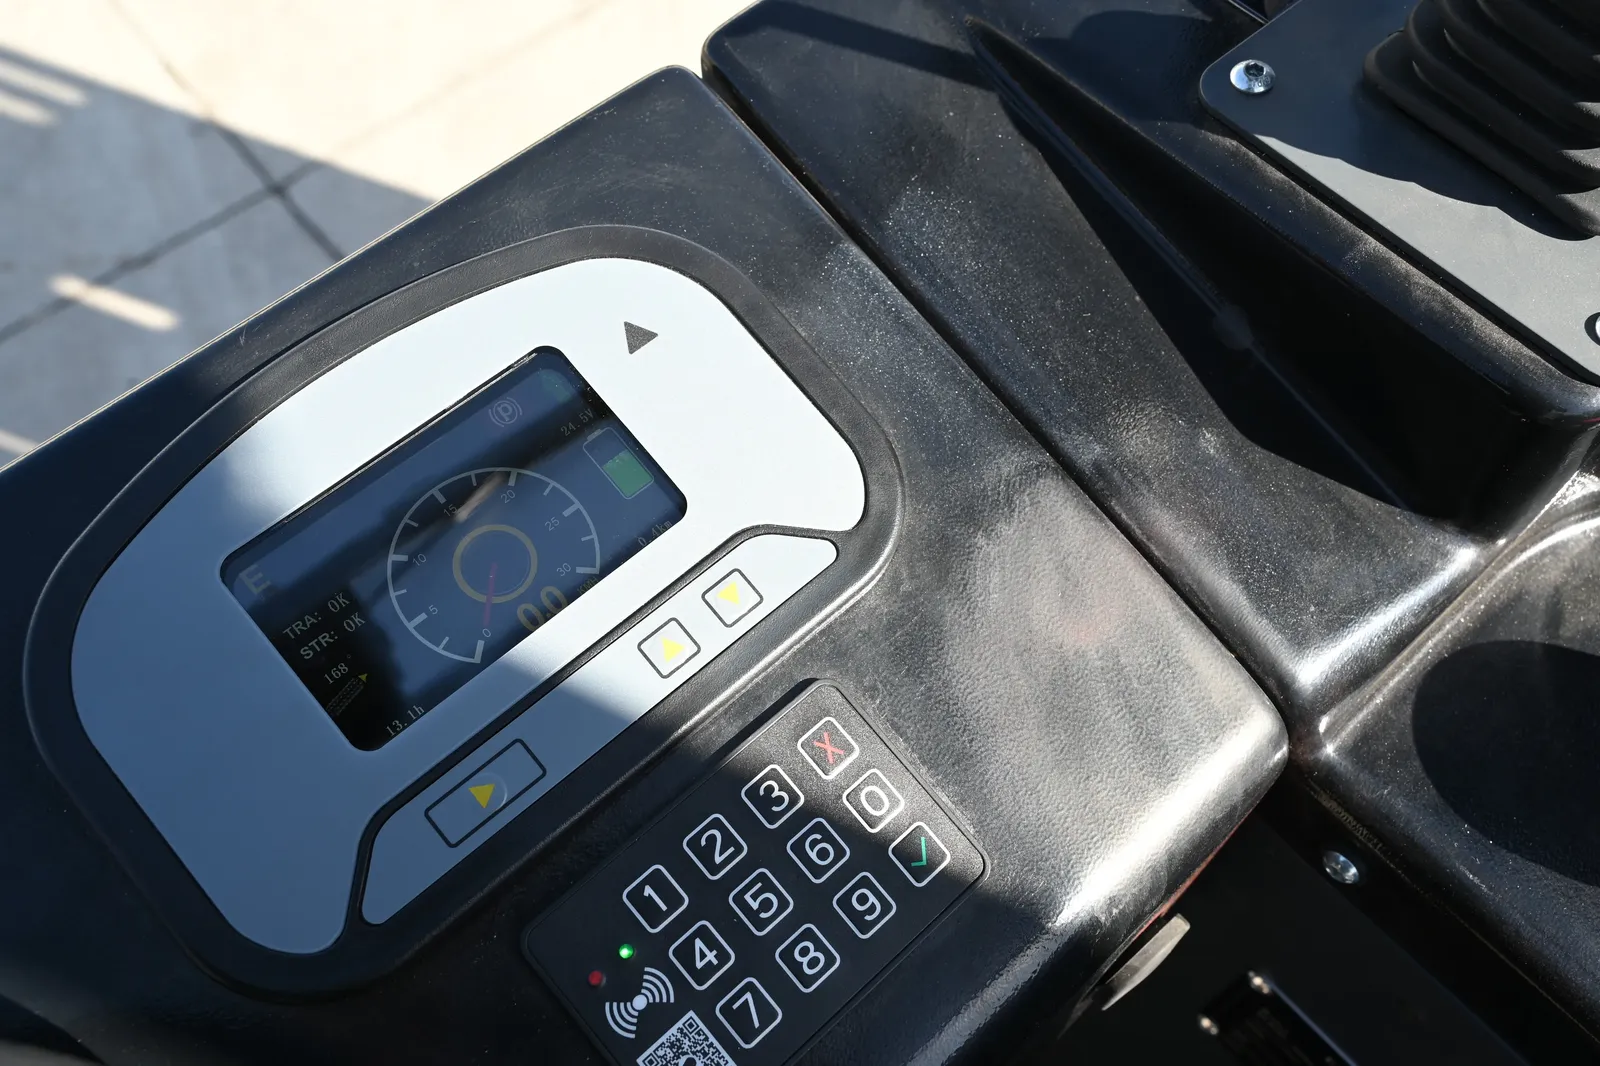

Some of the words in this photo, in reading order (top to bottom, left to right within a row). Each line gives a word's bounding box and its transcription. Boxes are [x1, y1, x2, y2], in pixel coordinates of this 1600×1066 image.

[560, 408, 594, 436] 24.5V
[443, 504, 458, 517] 15
[501, 489, 516, 504] 20
[544, 517, 560, 532] 25
[637, 519, 672, 547] 0.4km
[412, 553, 427, 567] 10
[556, 562, 572, 577] 30
[239, 564, 271, 595] E
[577, 576, 600, 595] KMH
[282, 611, 322, 640] TRA:
[327, 592, 350, 613] OK
[428, 604, 439, 615] 5
[516, 586, 568, 632] 0.0
[300, 631, 339, 660] STR:
[343, 612, 366, 632] OK
[482, 628, 492, 638] 0
[385, 704, 425, 736] 13.1h
[759, 780, 790, 812] 3
[860, 785, 890, 816] 0
[700, 829, 735, 865] 2
[804, 833, 834, 866] 6
[643, 884, 668, 912] 1
[743, 882, 779, 918] 5
[851, 888, 881, 921] 9
[693, 937, 718, 970] 4
[793, 940, 825, 975] 8
[732, 991, 760, 1029] 7
